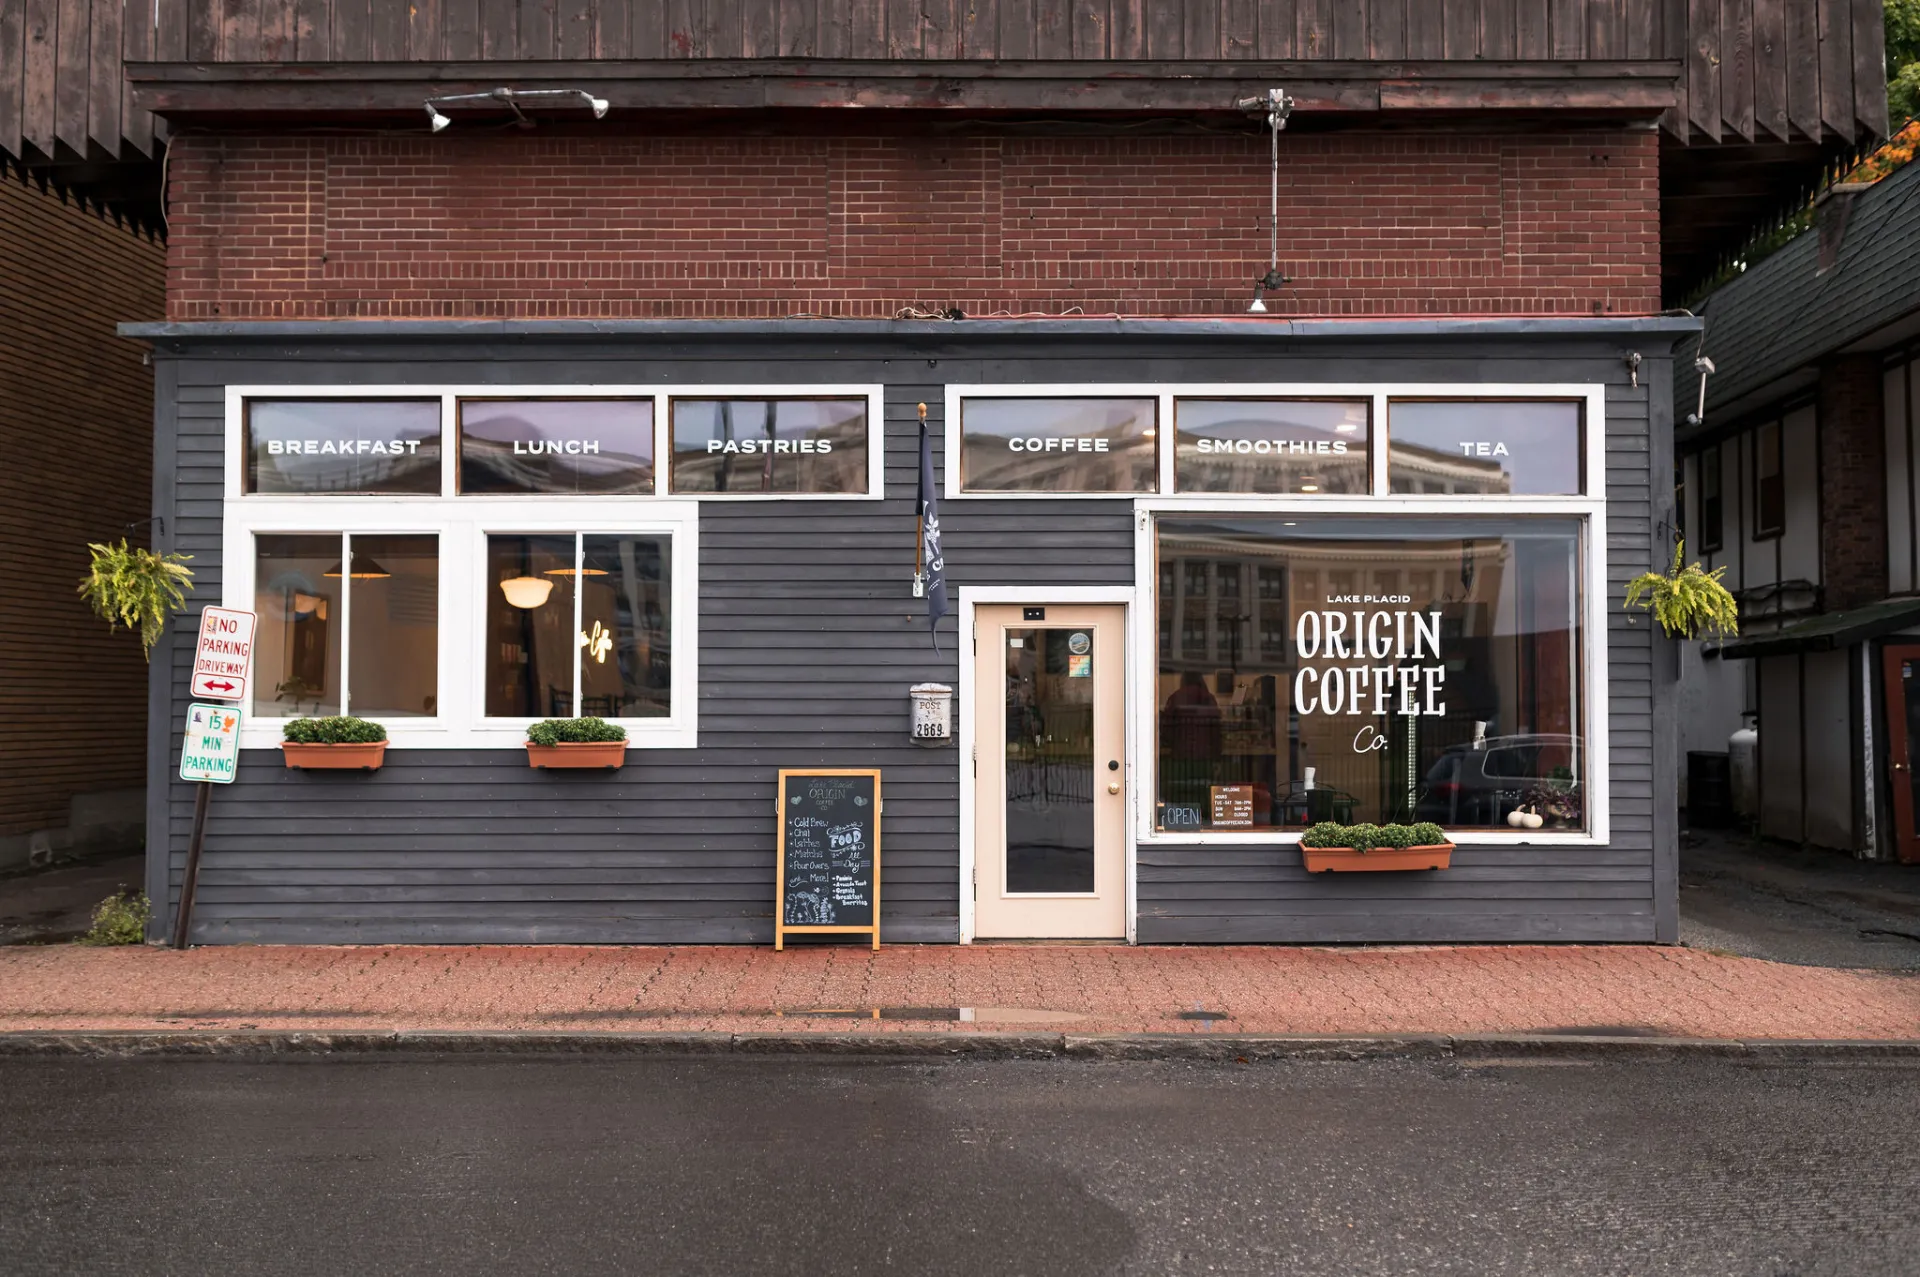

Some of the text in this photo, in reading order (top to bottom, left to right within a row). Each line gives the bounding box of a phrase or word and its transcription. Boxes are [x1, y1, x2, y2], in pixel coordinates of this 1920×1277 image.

[267, 440, 421, 455] BREAKFAST
[513, 440, 599, 455] LUNCH
[707, 439, 832, 454] PASTRIES
[1008, 437, 1109, 452] COFFEE
[1196, 439, 1348, 455] SMOOTHIES
[1459, 441, 1509, 456] TEA
[1327, 595, 1411, 603] LAKE PLACID
[219, 618, 238, 634] NO
[1296, 610, 1443, 659] ORIGIN
[201, 637, 249, 657] PARKING
[198, 658, 244, 675] DRIVEWAY
[1294, 664, 1446, 717] COFFEE
[919, 701, 941, 709] POST
[209, 715, 222, 730] 15
[916, 723, 943, 736] 2669
[201, 735, 222, 751] MIN
[1353, 725, 1388, 754] Co.
[185, 755, 232, 773] PARKING
[809, 788, 846, 799] ORIGIN
[794, 817, 829, 827] Cold Brew
[1167, 807, 1199, 825] OPEN
[794, 838, 821, 848] Lattes
[829, 830, 862, 849] FOOD
[793, 848, 823, 858] Matcha
[793, 860, 809, 870] Pour
